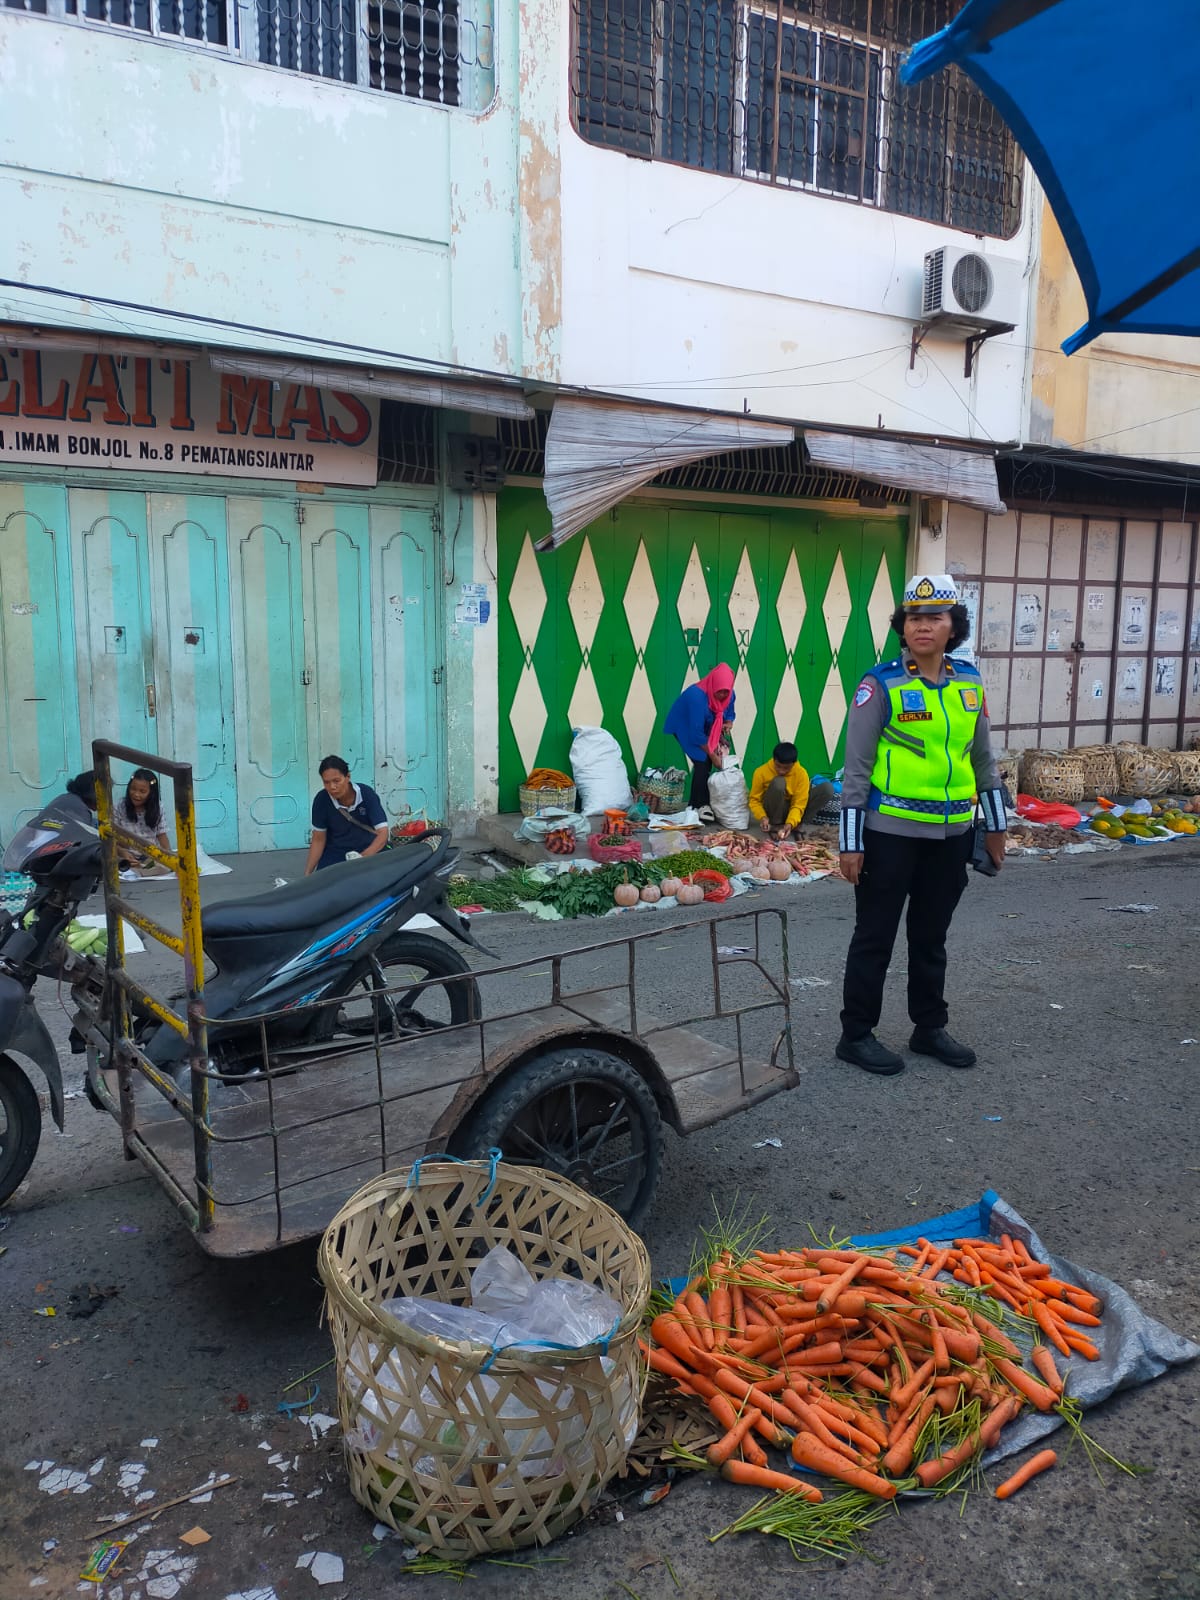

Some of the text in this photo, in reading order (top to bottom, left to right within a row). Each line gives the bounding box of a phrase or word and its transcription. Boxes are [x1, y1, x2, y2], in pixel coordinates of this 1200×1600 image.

[216, 373, 372, 446] MAS
[68, 436, 132, 458] BONJOL
[181, 445, 314, 471] PEMATANGSIANTAR
